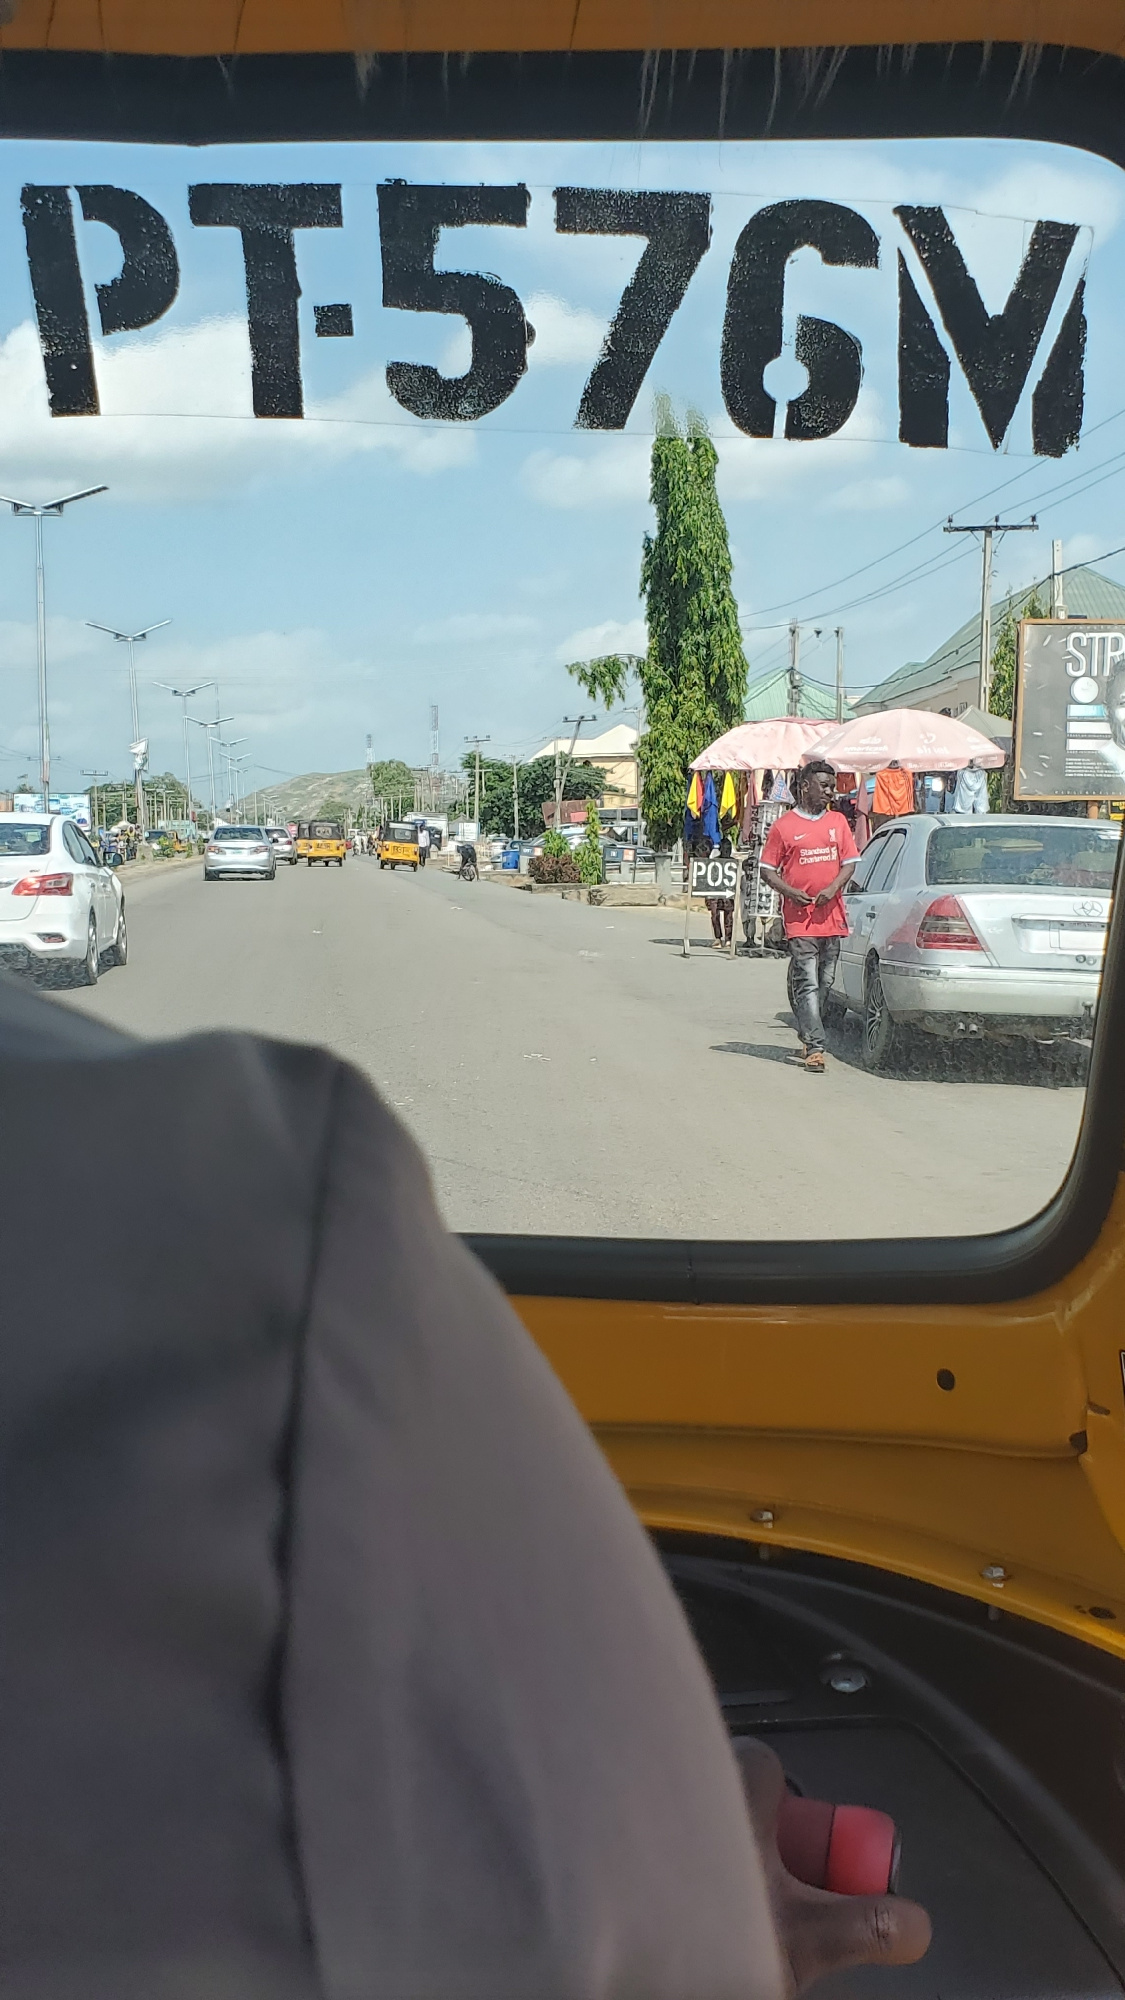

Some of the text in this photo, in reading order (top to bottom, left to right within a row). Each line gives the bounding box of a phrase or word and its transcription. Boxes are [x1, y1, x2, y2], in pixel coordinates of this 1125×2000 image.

[20, 178, 1087, 457] PT-576M
[799, 846, 830, 857] Standard
[799, 854, 831, 865] Chartered
[692, 861, 737, 887] POS
